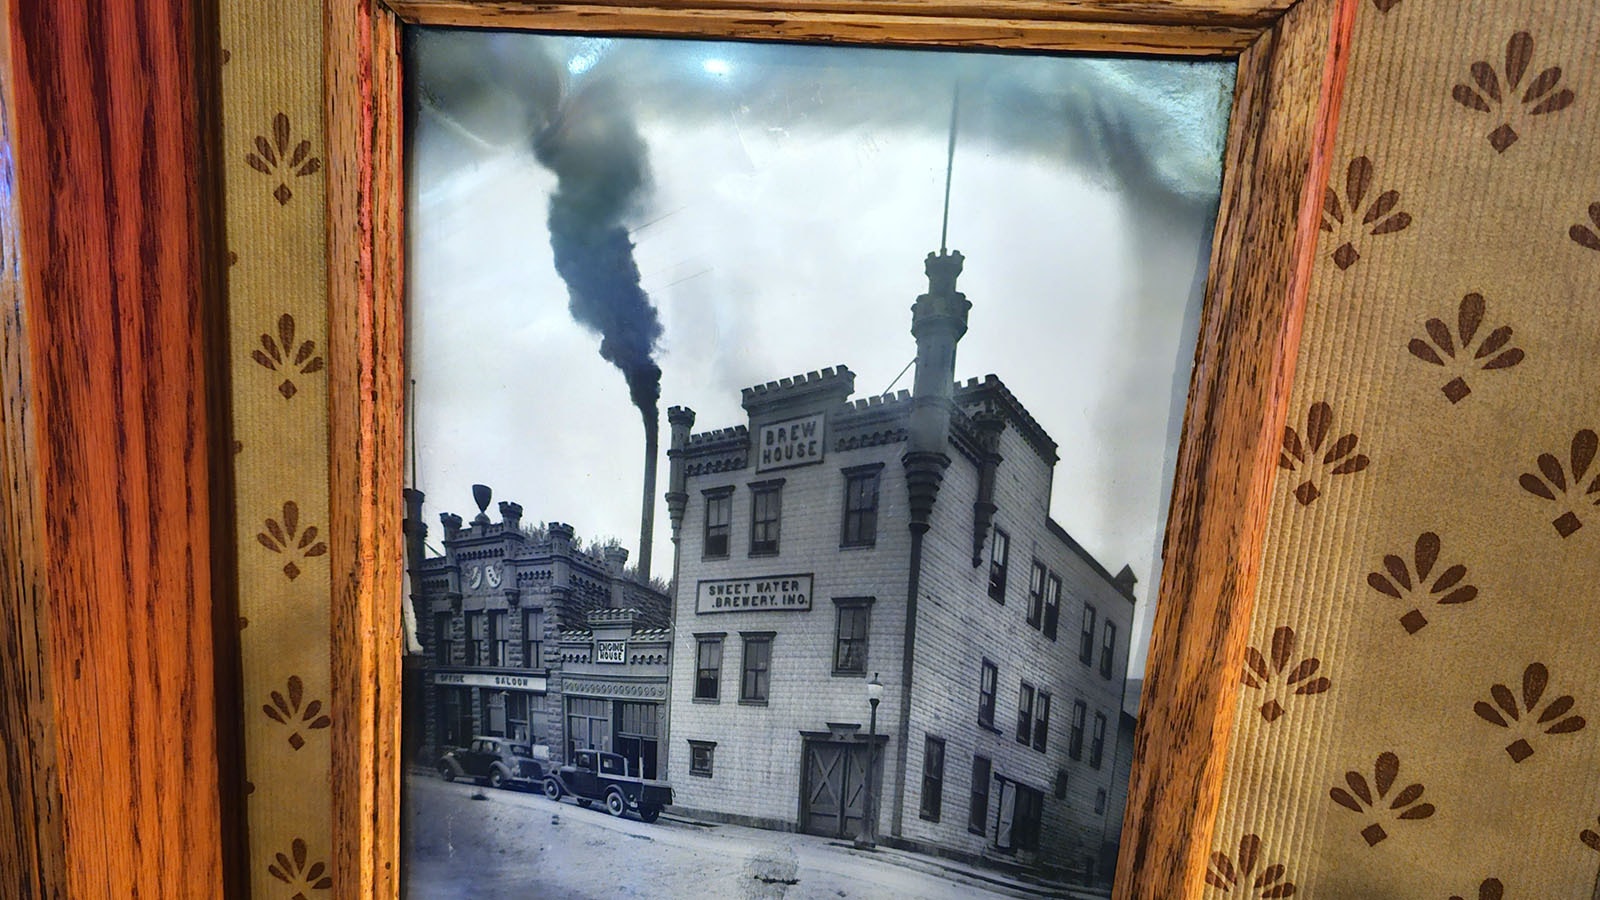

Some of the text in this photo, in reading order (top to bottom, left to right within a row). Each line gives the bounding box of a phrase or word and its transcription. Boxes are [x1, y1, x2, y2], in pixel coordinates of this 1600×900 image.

[763, 441, 817, 464] HOUSE
[709, 580, 799, 596] SWEET WATER
[599, 651, 622, 660] HOUSE
[495, 676, 528, 687] SALOON
